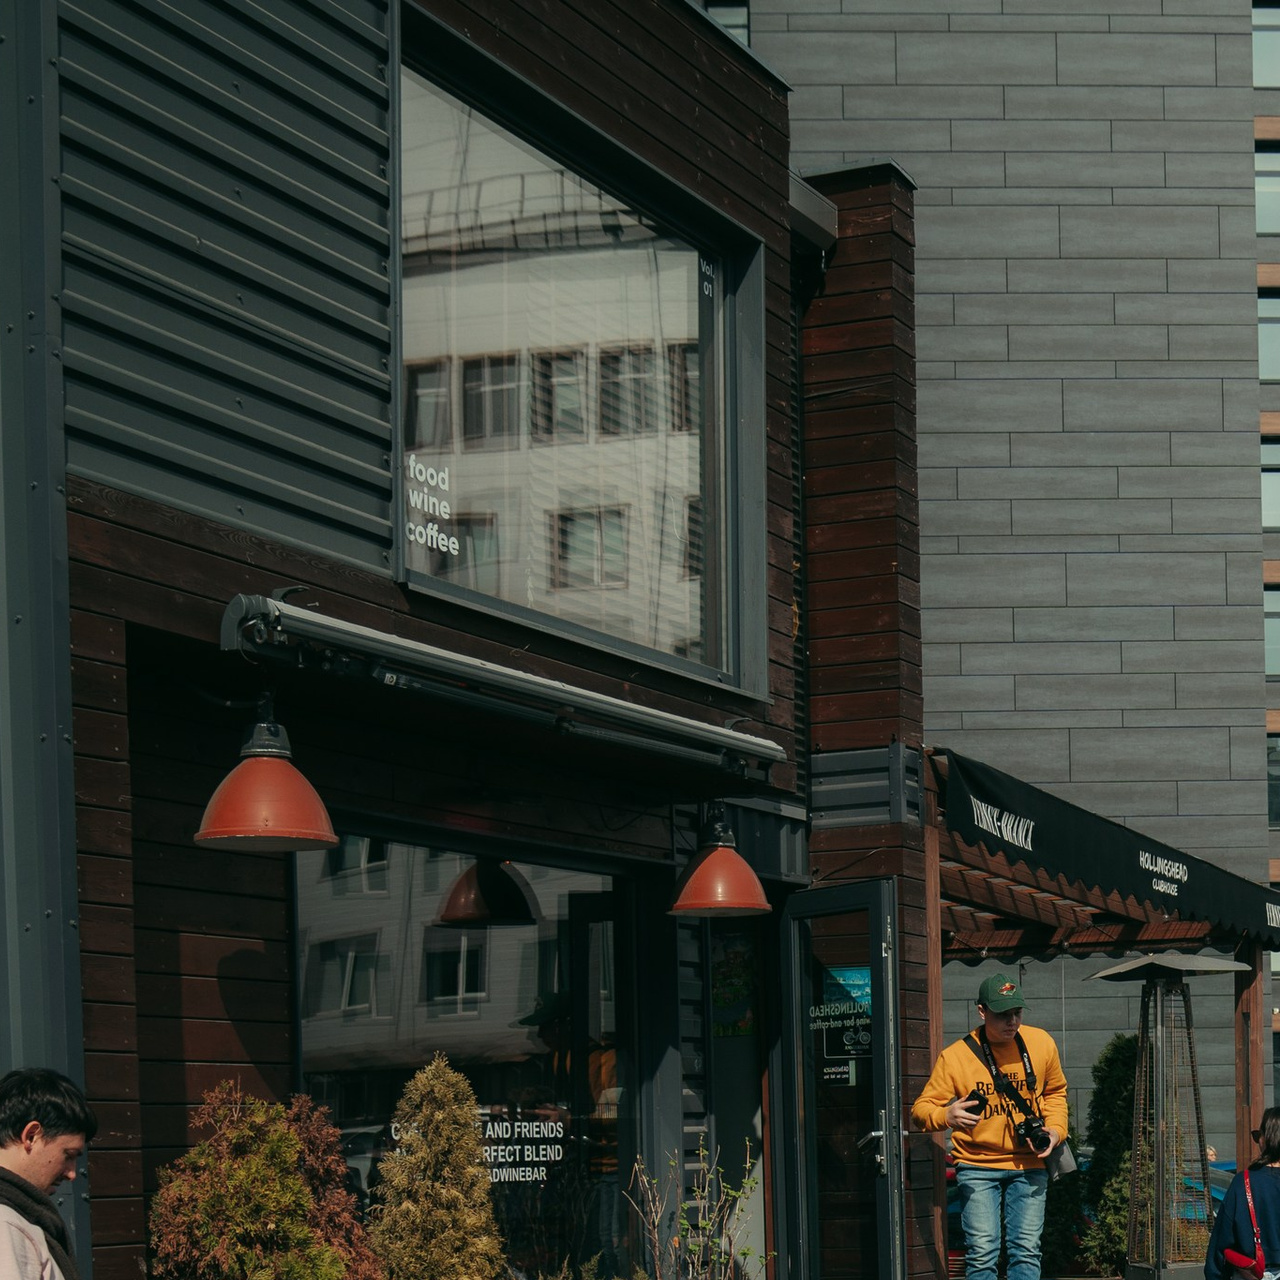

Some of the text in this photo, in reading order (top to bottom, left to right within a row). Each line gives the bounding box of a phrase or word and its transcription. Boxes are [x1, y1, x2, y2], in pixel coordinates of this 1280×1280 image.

[700, 258, 715, 279] Vol.
[703, 281, 713, 298] 01
[409, 454, 449, 491] food
[409, 487, 451, 520] wine
[405, 521, 460, 556] coffee
[1139, 850, 1189, 883] HOLLINGSHEAD
[1152, 878, 1178, 896] CLUBHOUSE
[485, 1122, 511, 1139] AND
[514, 1121, 564, 1138] FRIENDS
[482, 1144, 563, 1162] RFECT BLEND
